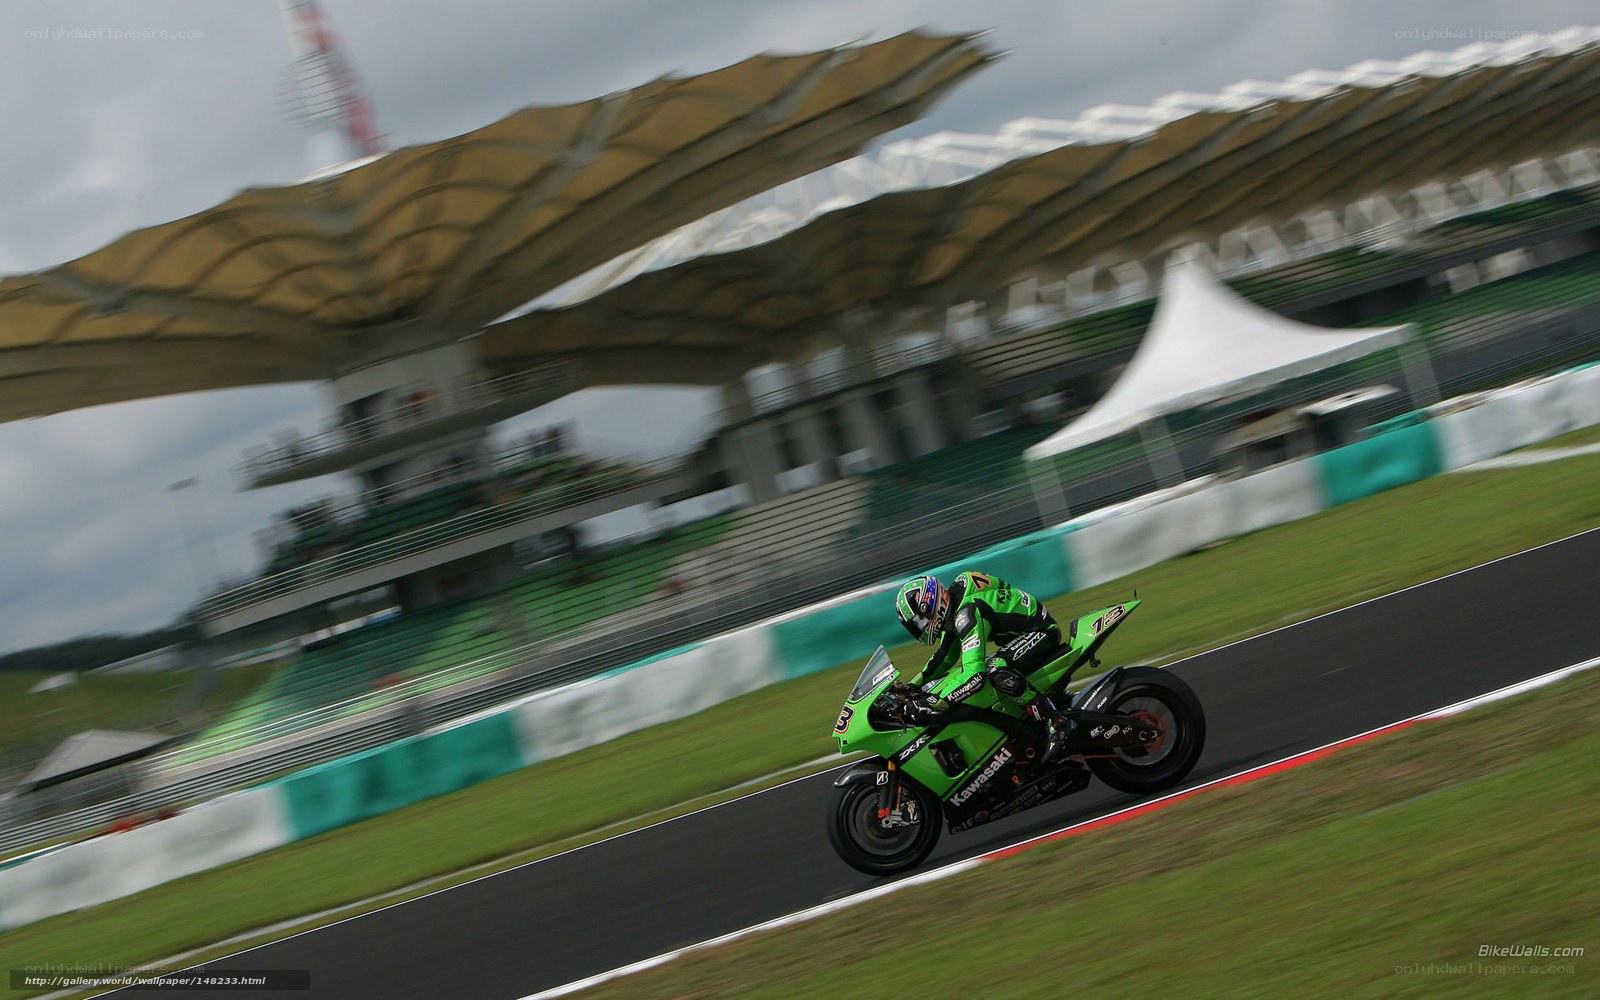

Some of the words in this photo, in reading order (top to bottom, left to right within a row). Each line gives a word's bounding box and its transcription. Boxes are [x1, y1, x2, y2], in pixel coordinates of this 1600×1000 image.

[1090, 604, 1126, 638] 13
[947, 672, 983, 702] Kawasaki
[949, 747, 1012, 807] Kawasaki
